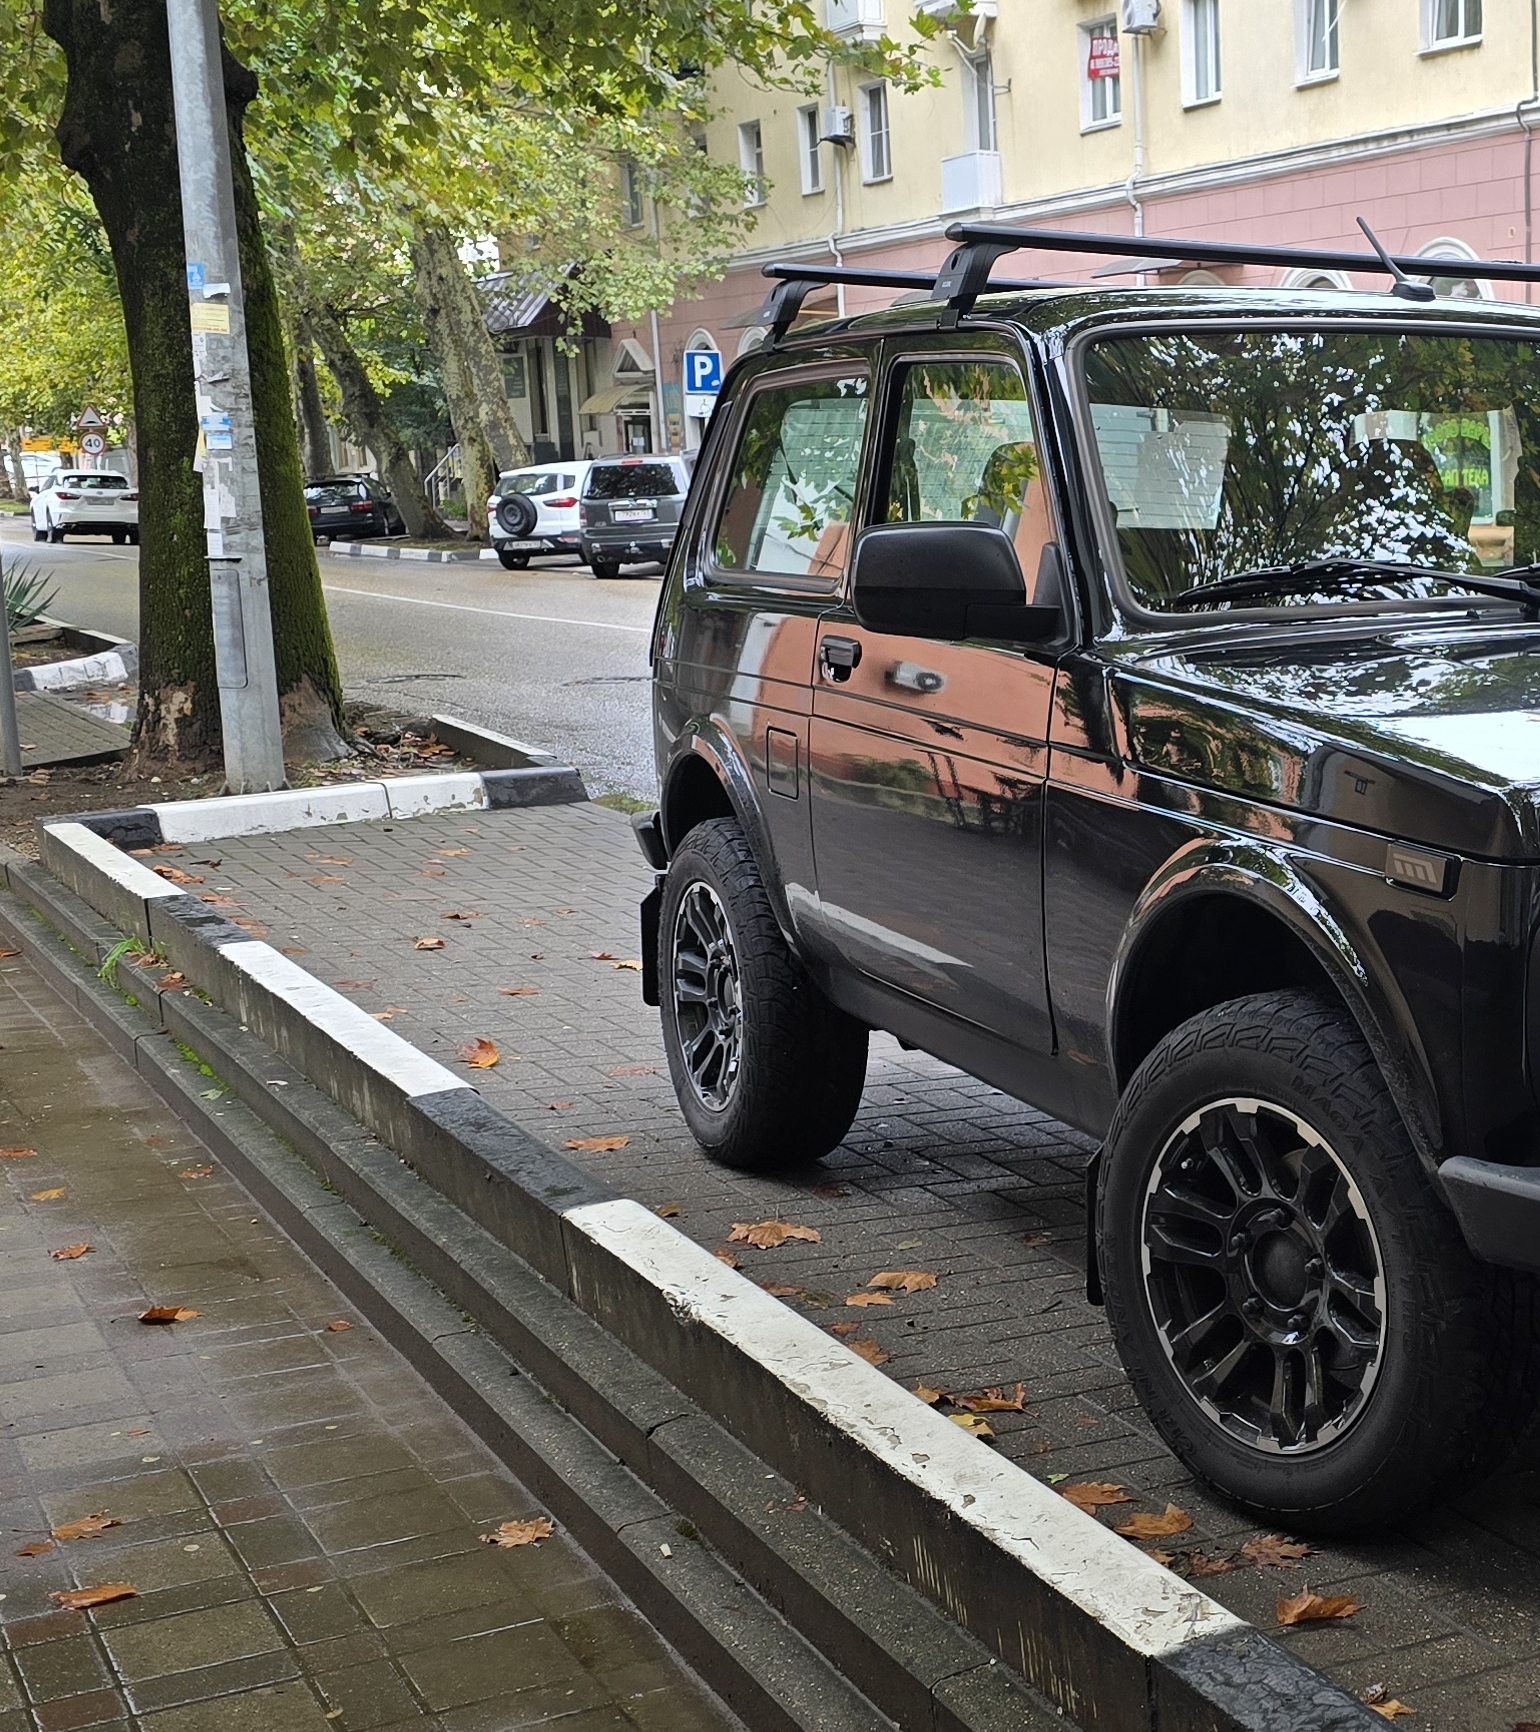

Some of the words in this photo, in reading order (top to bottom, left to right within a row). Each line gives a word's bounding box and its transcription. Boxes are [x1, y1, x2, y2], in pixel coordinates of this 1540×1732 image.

[694, 355, 713, 388] P
[85, 438, 101, 448] 40
[1290, 1072, 1366, 1155] MAGA
